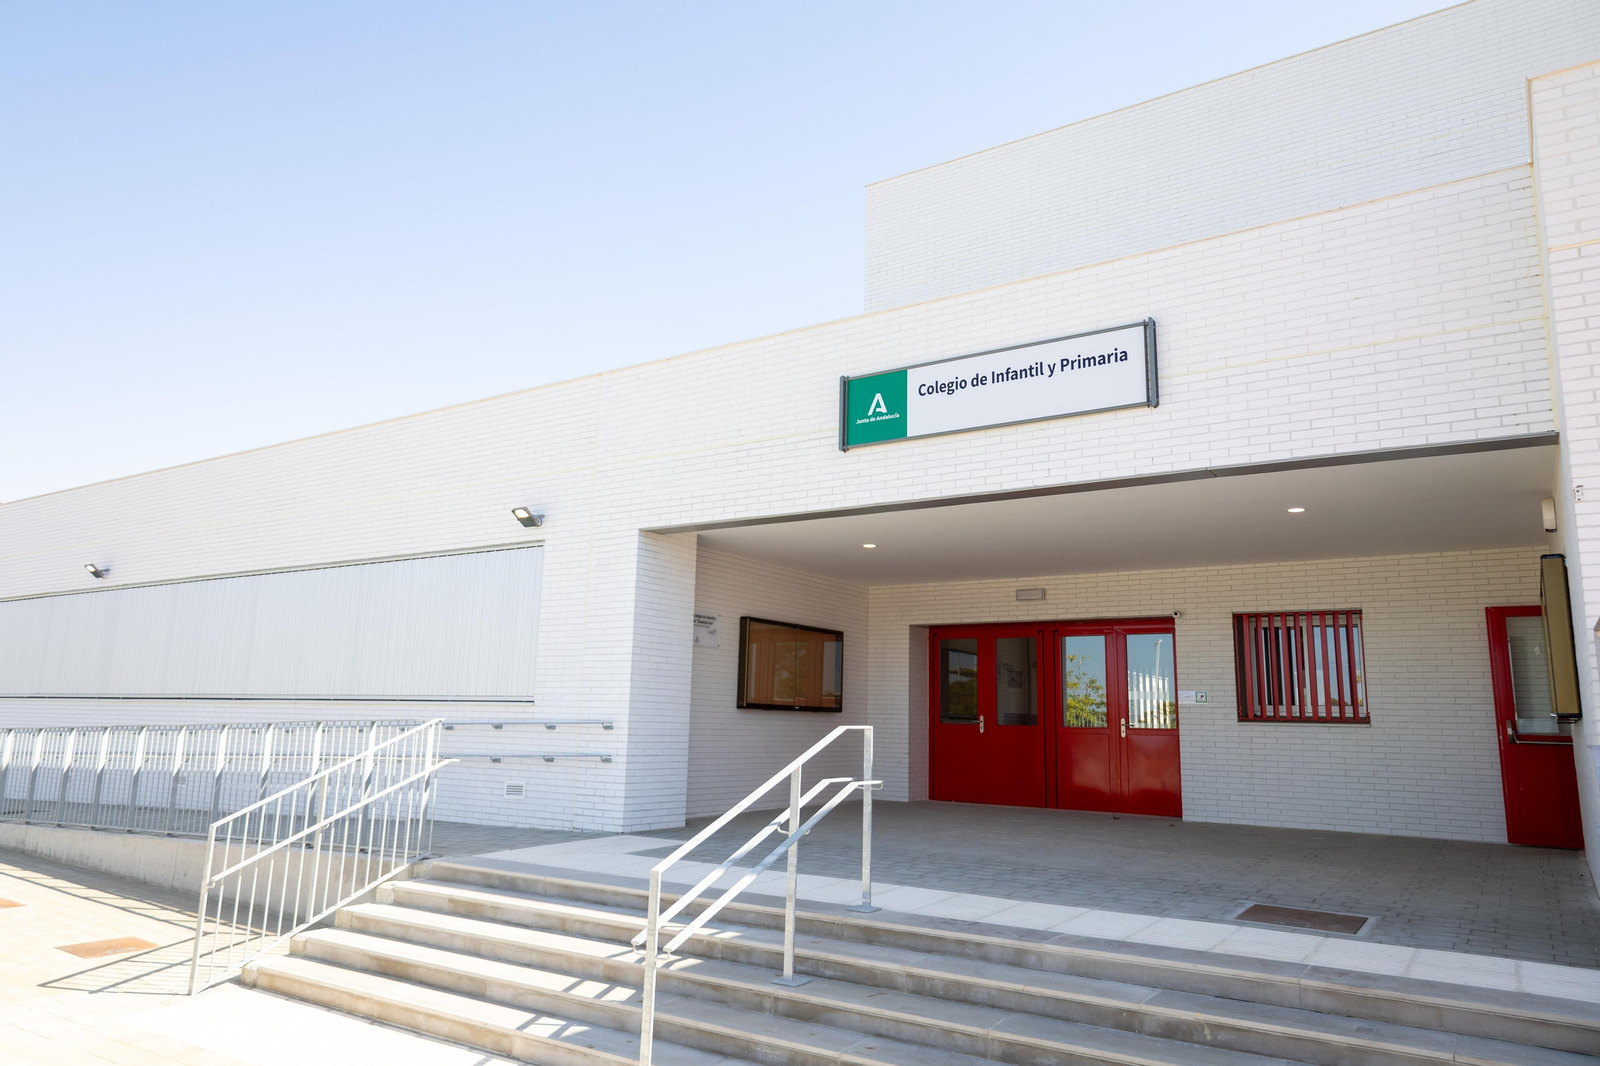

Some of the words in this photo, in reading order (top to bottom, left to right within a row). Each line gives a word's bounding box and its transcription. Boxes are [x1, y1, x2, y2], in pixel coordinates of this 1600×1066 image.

[918, 375, 968, 397] Colegio
[970, 373, 988, 388] de
[991, 361, 1045, 384] Infantil
[1047, 362, 1057, 378] y
[1060, 347, 1129, 372] Primaria
[876, 411, 900, 422] Andalucía
